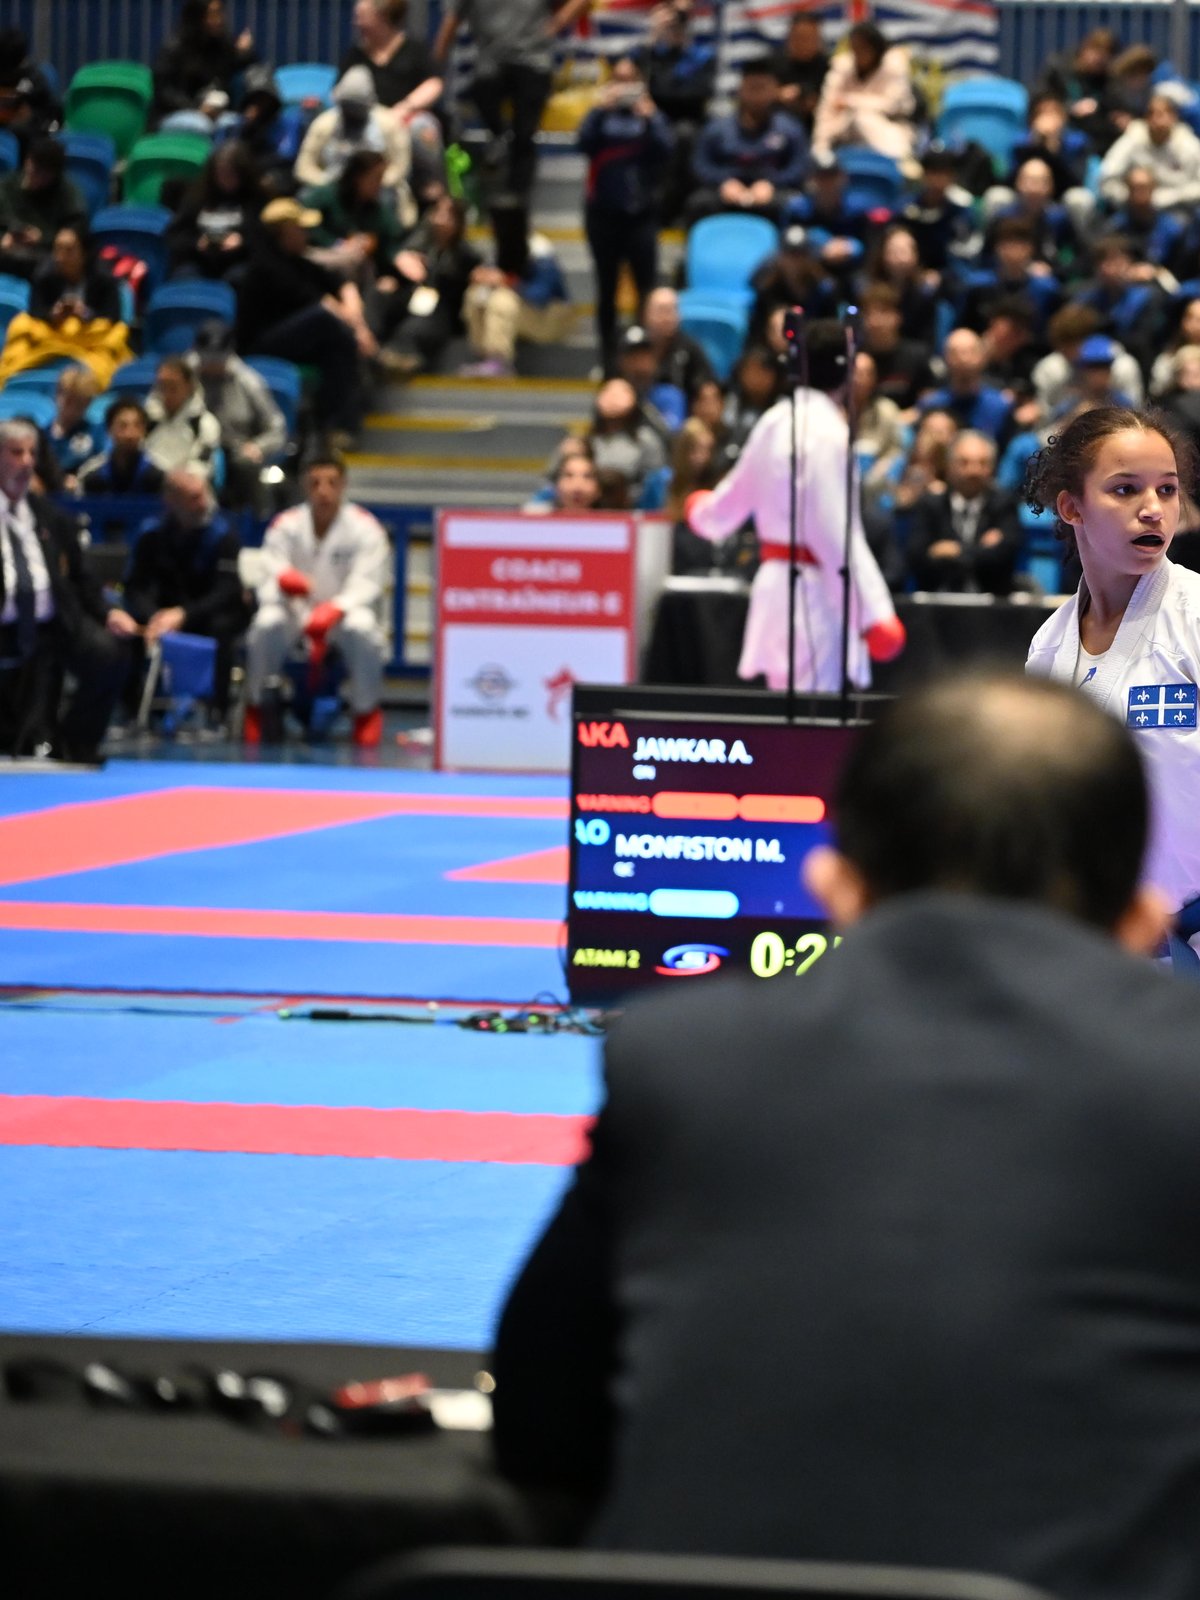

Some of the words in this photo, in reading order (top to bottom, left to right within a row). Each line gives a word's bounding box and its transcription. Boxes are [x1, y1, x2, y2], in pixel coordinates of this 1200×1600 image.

[491, 557, 582, 583] COACH
[632, 736, 726, 764] JAWKAR
[728, 739, 753, 765] A.
[615, 834, 752, 862] MONFISTON
[755, 838, 785, 863] M.
[750, 931, 844, 978] 0:2
